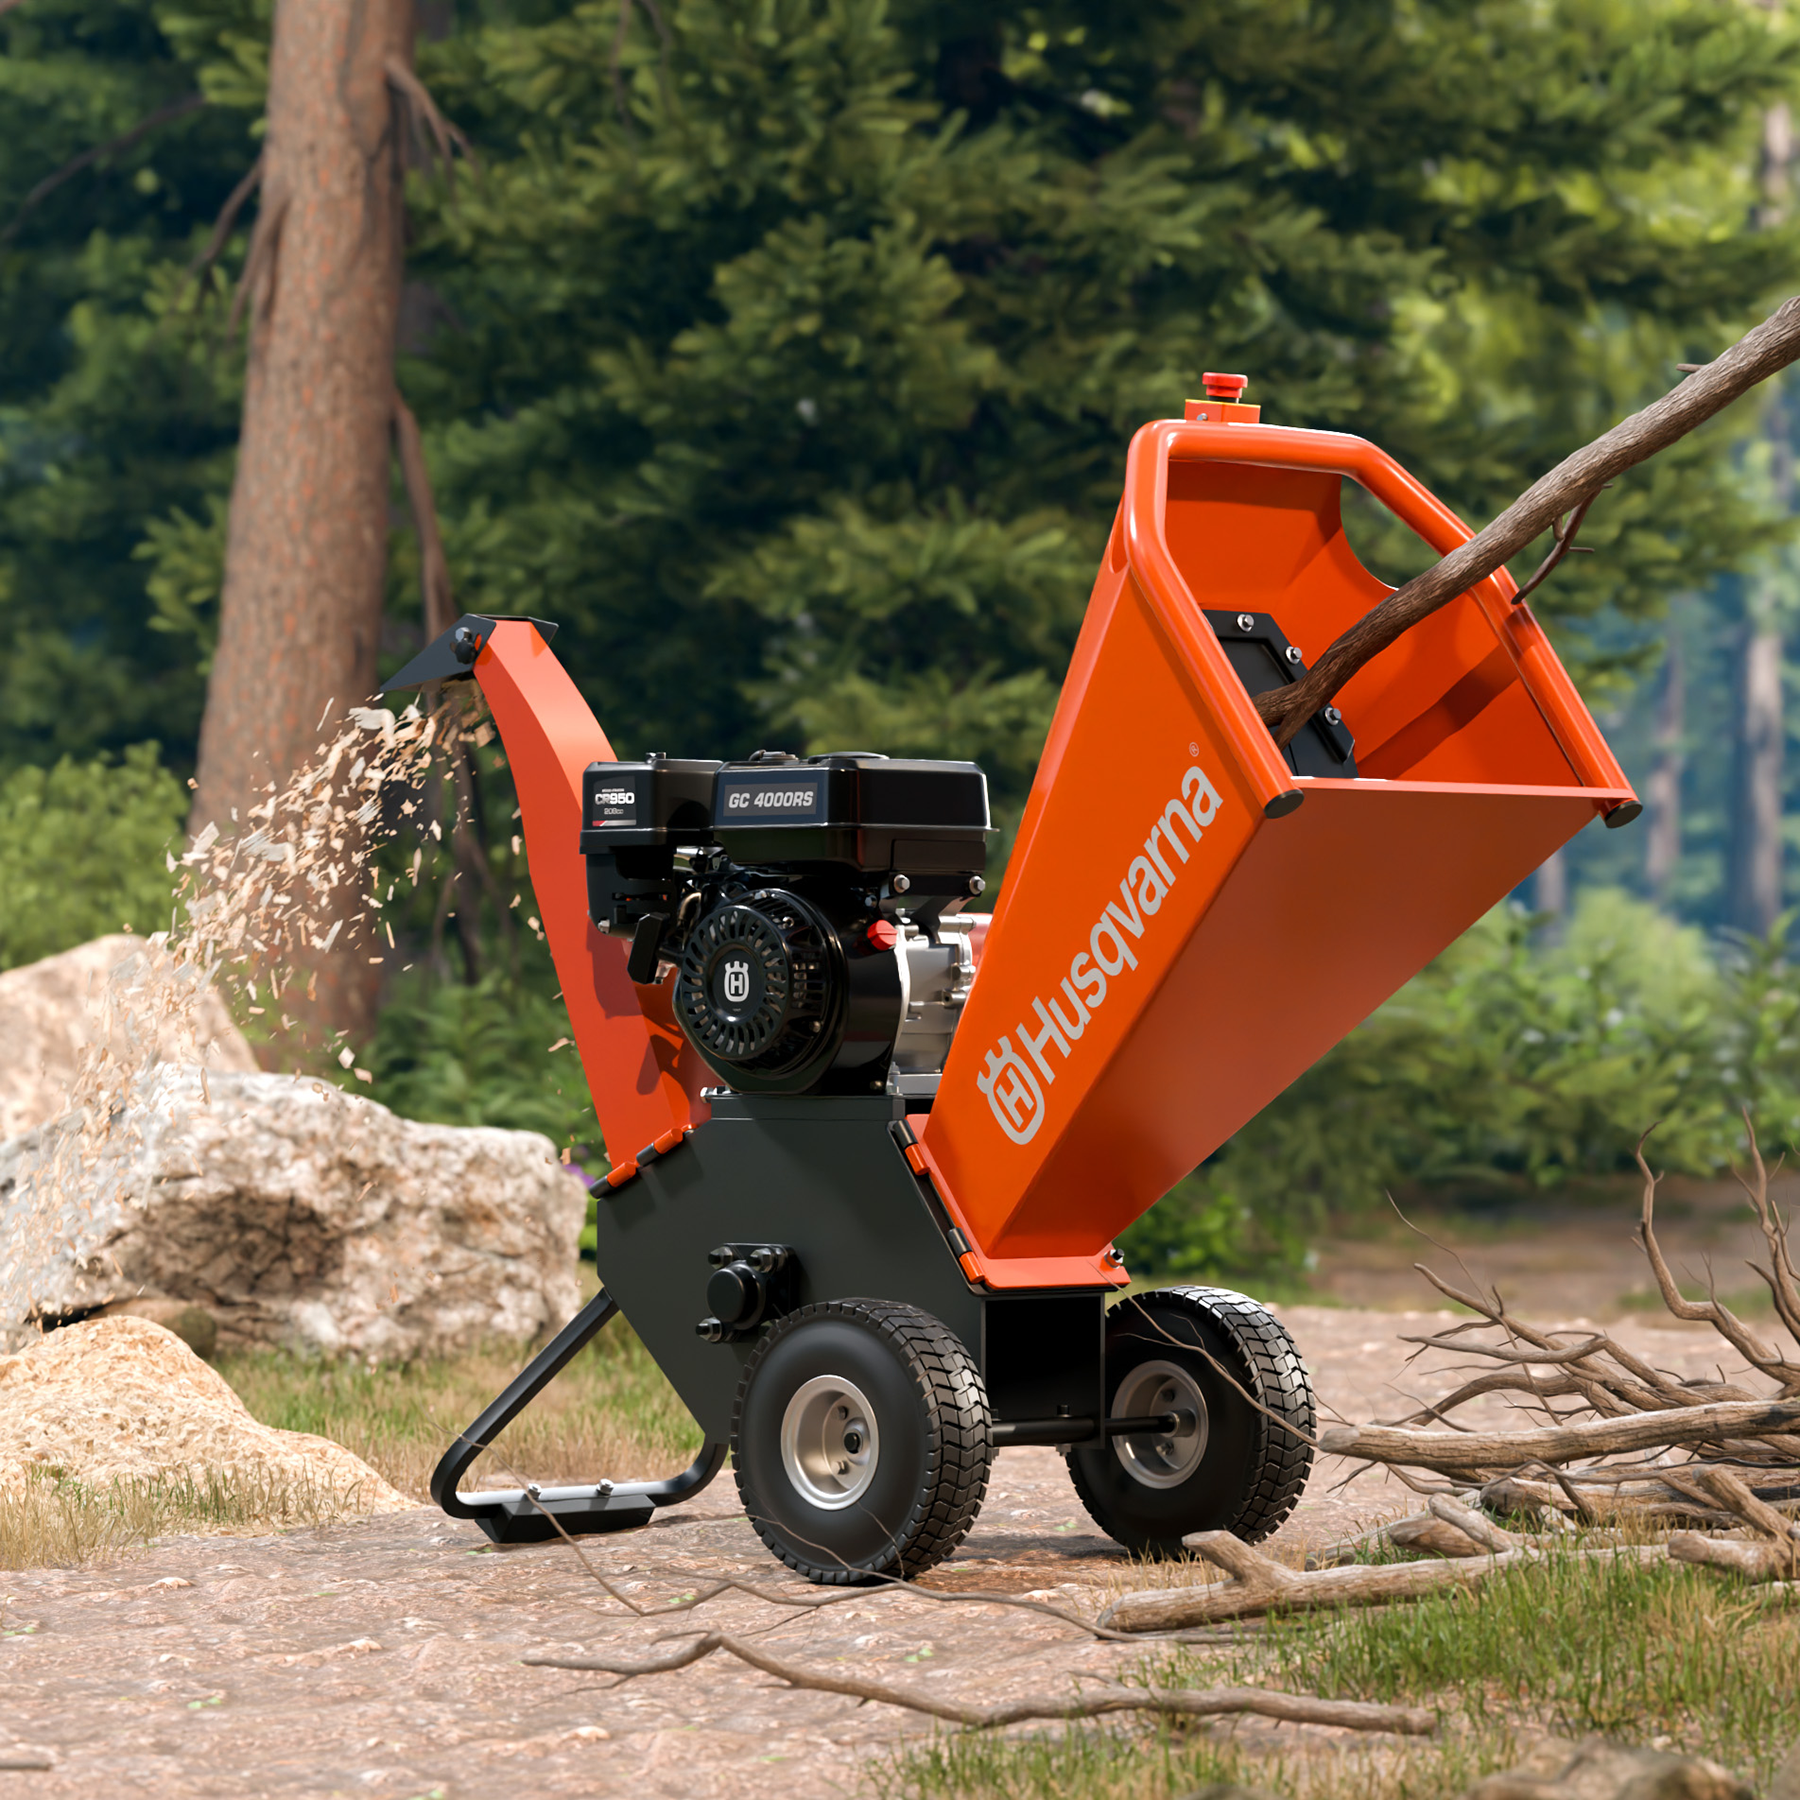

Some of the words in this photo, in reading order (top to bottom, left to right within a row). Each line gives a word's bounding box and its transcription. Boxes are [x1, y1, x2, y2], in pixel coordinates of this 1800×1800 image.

[595, 792, 635, 805] CR950
[728, 793, 750, 808] GC
[754, 791, 814, 807] 4000RS
[1015, 765, 1224, 1085] Husqvarna
